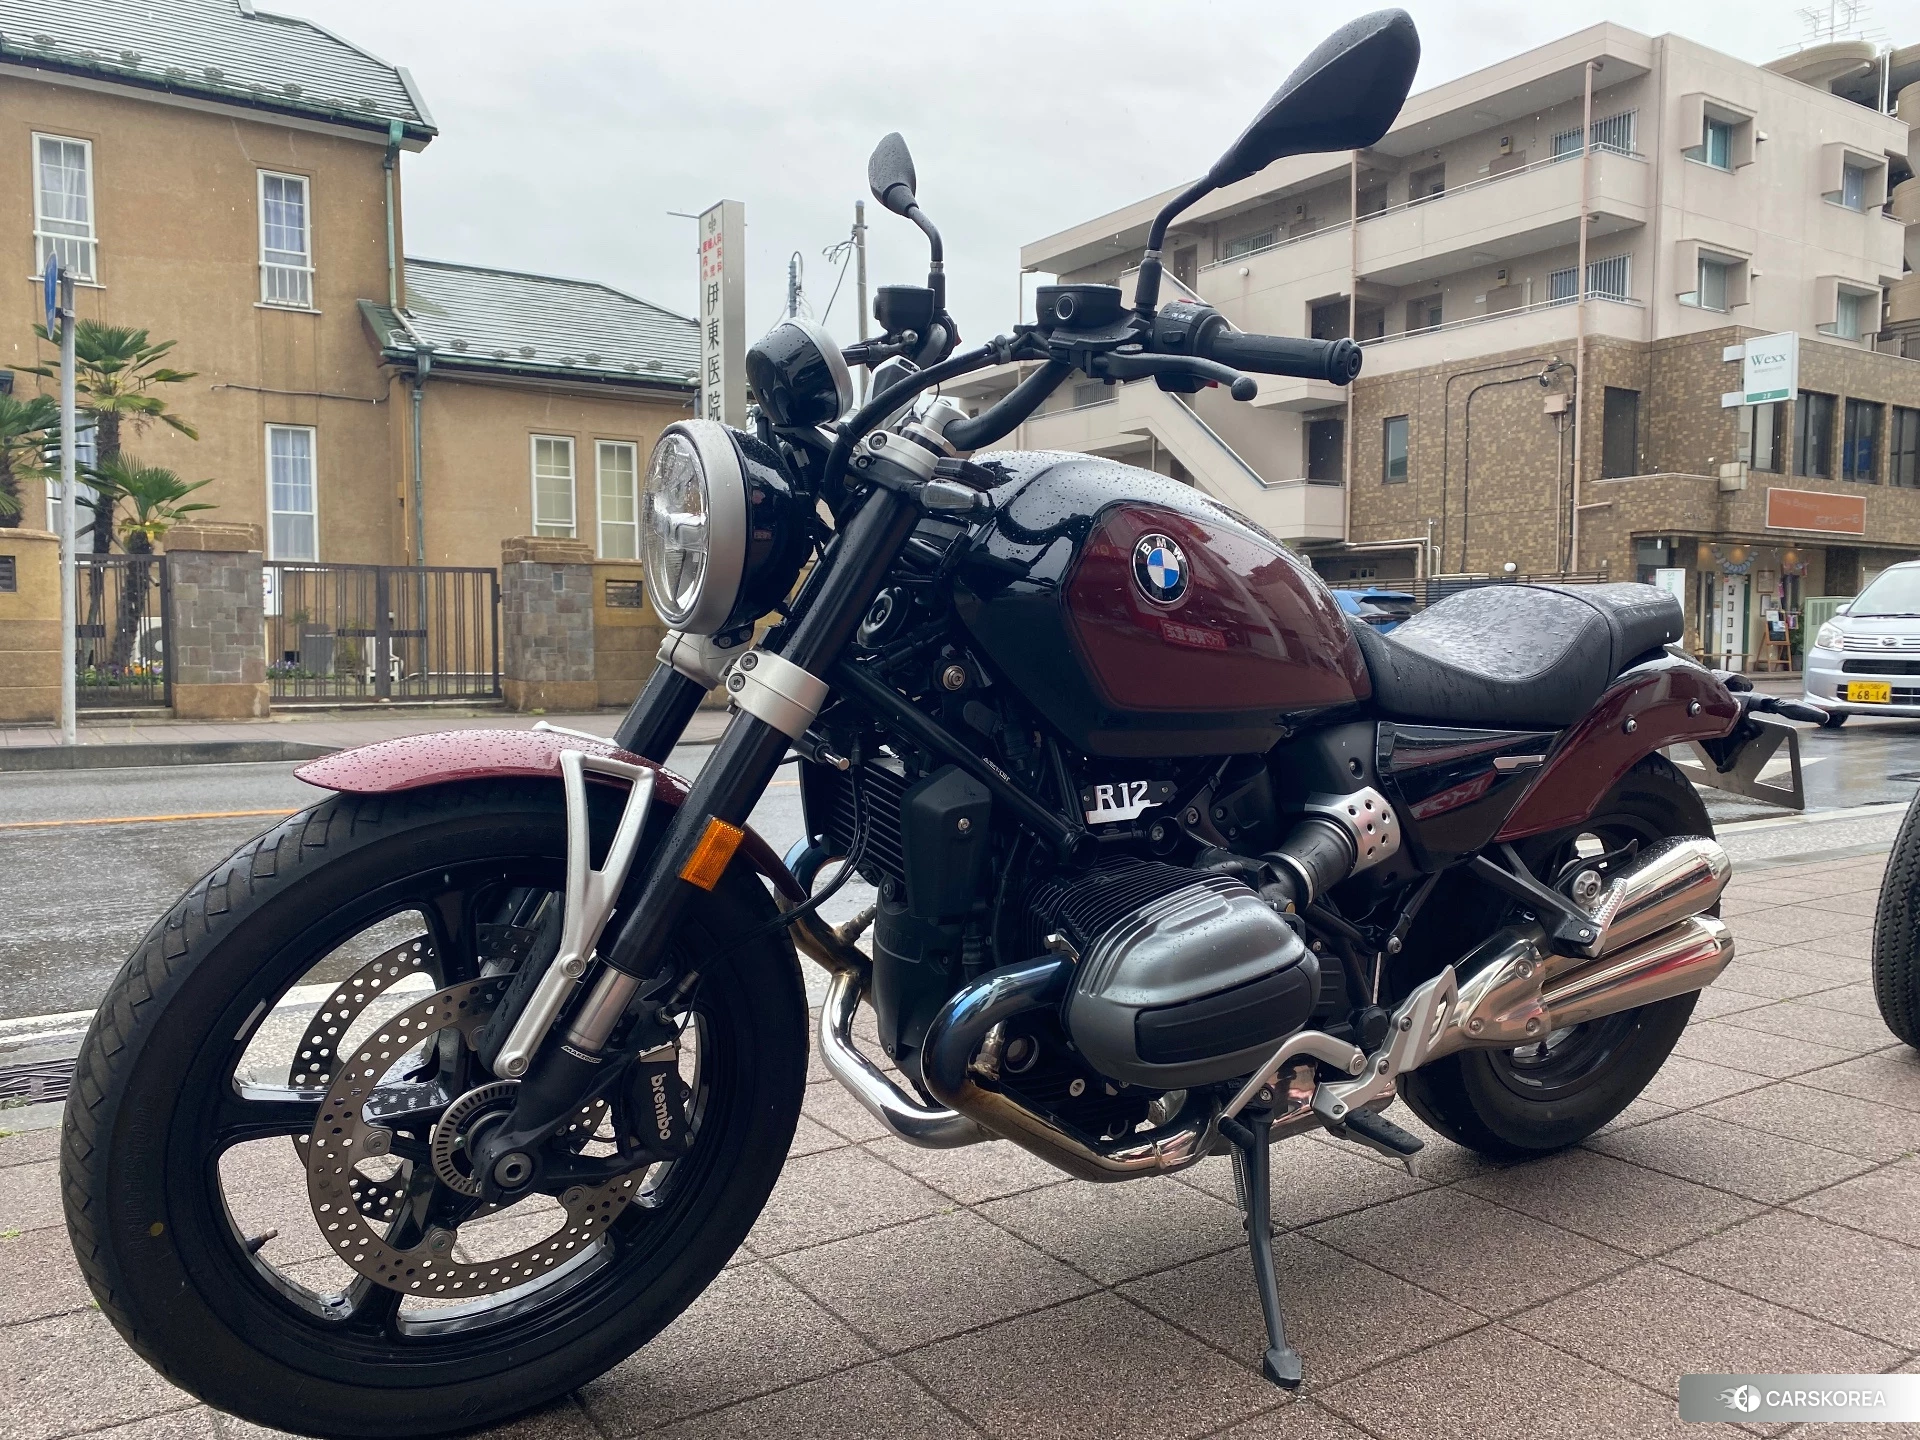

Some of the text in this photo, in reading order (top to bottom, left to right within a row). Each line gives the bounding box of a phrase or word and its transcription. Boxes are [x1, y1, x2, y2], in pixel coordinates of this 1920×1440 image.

[707, 281, 721, 421] 伊東医院
[1751, 353, 1787, 366] Wexx
[1140, 537, 1186, 562] BMW
[1857, 690, 1887, 701] 68-14
[650, 1072, 673, 1140] brembo
